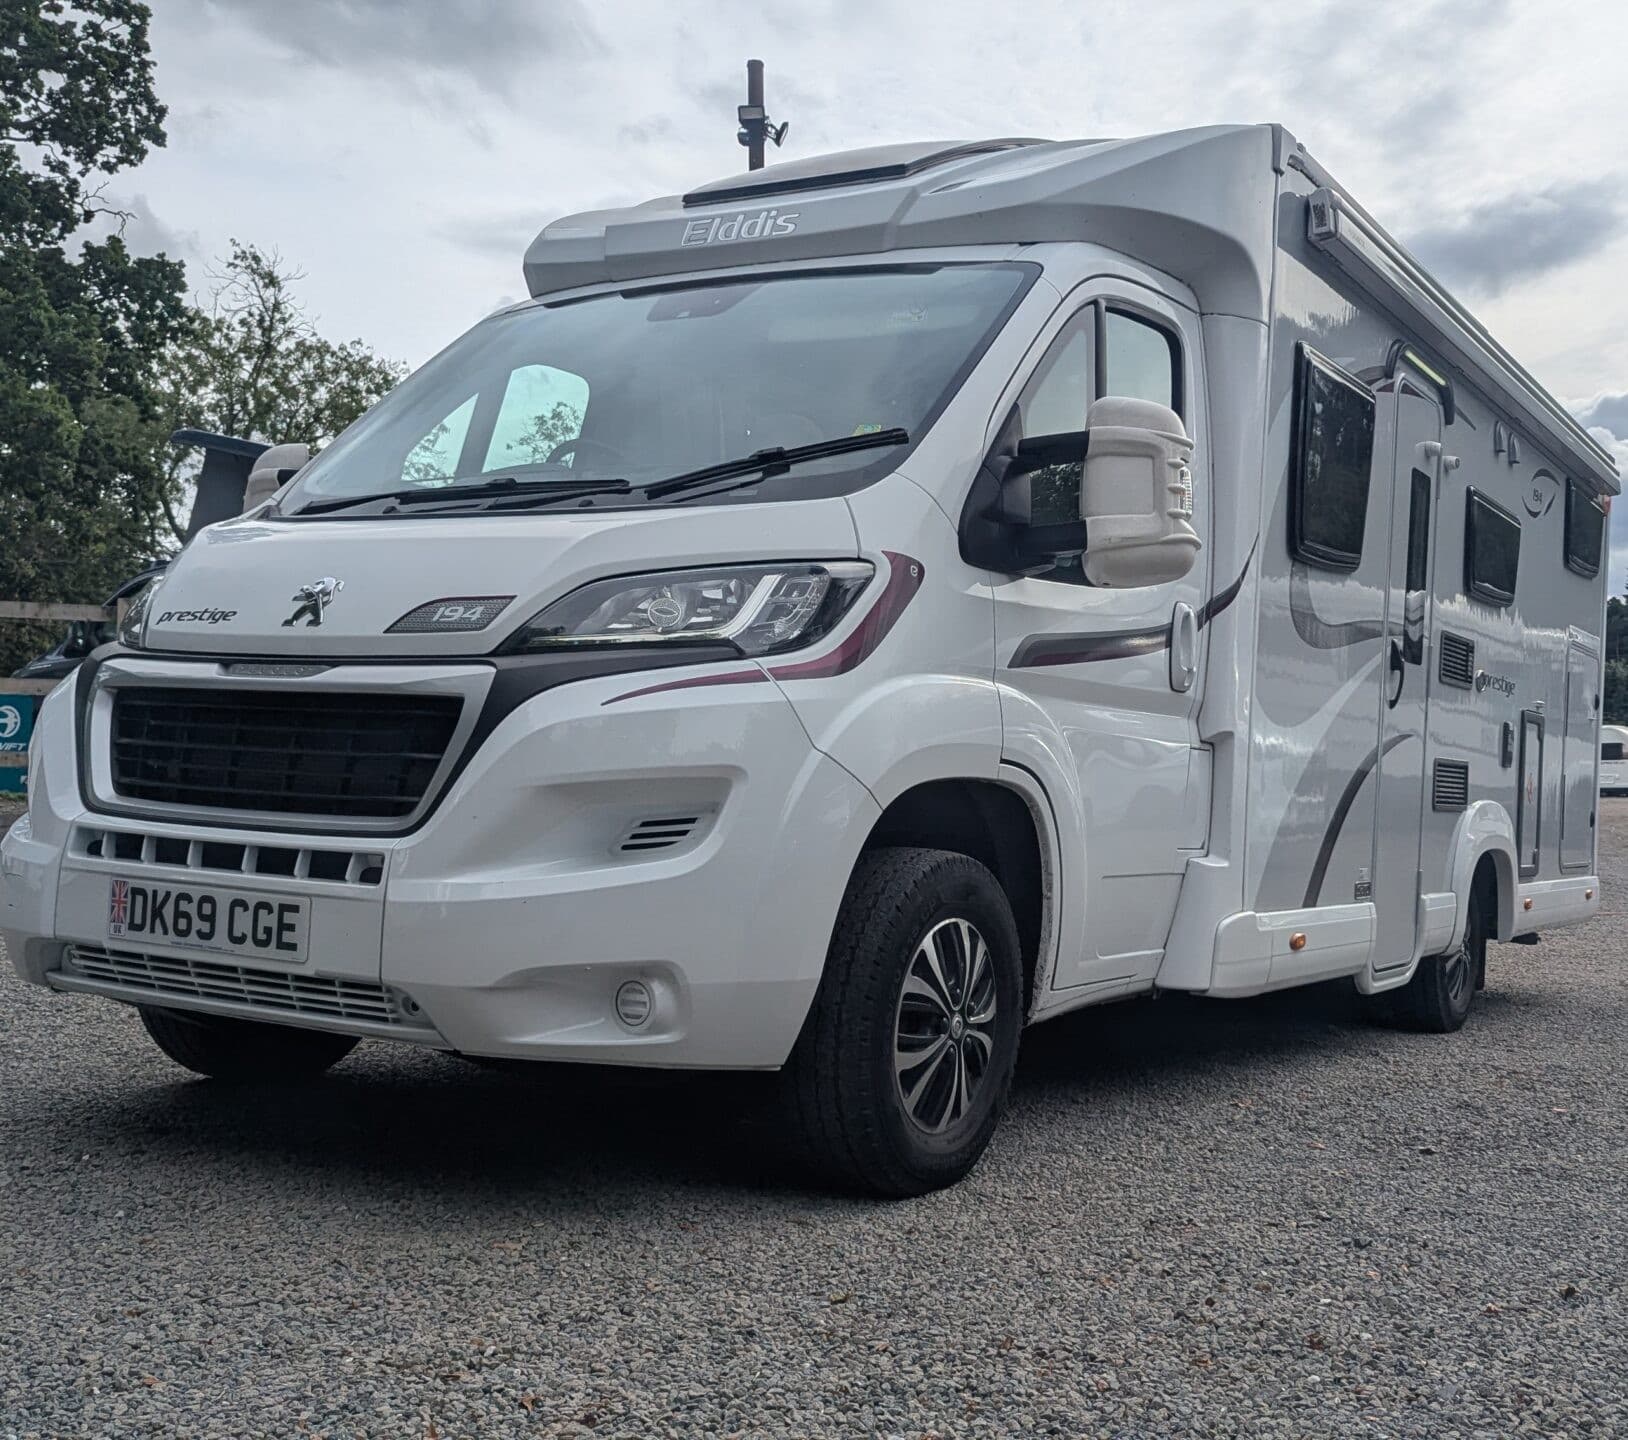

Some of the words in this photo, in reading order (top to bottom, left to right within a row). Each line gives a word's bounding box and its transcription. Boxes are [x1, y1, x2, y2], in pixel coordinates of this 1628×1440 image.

[681, 210, 800, 247] Elddis
[155, 607, 238, 625] prestige
[432, 606, 485, 621] 194
[127, 886, 217, 940] DK69
[227, 898, 300, 951] CGE
